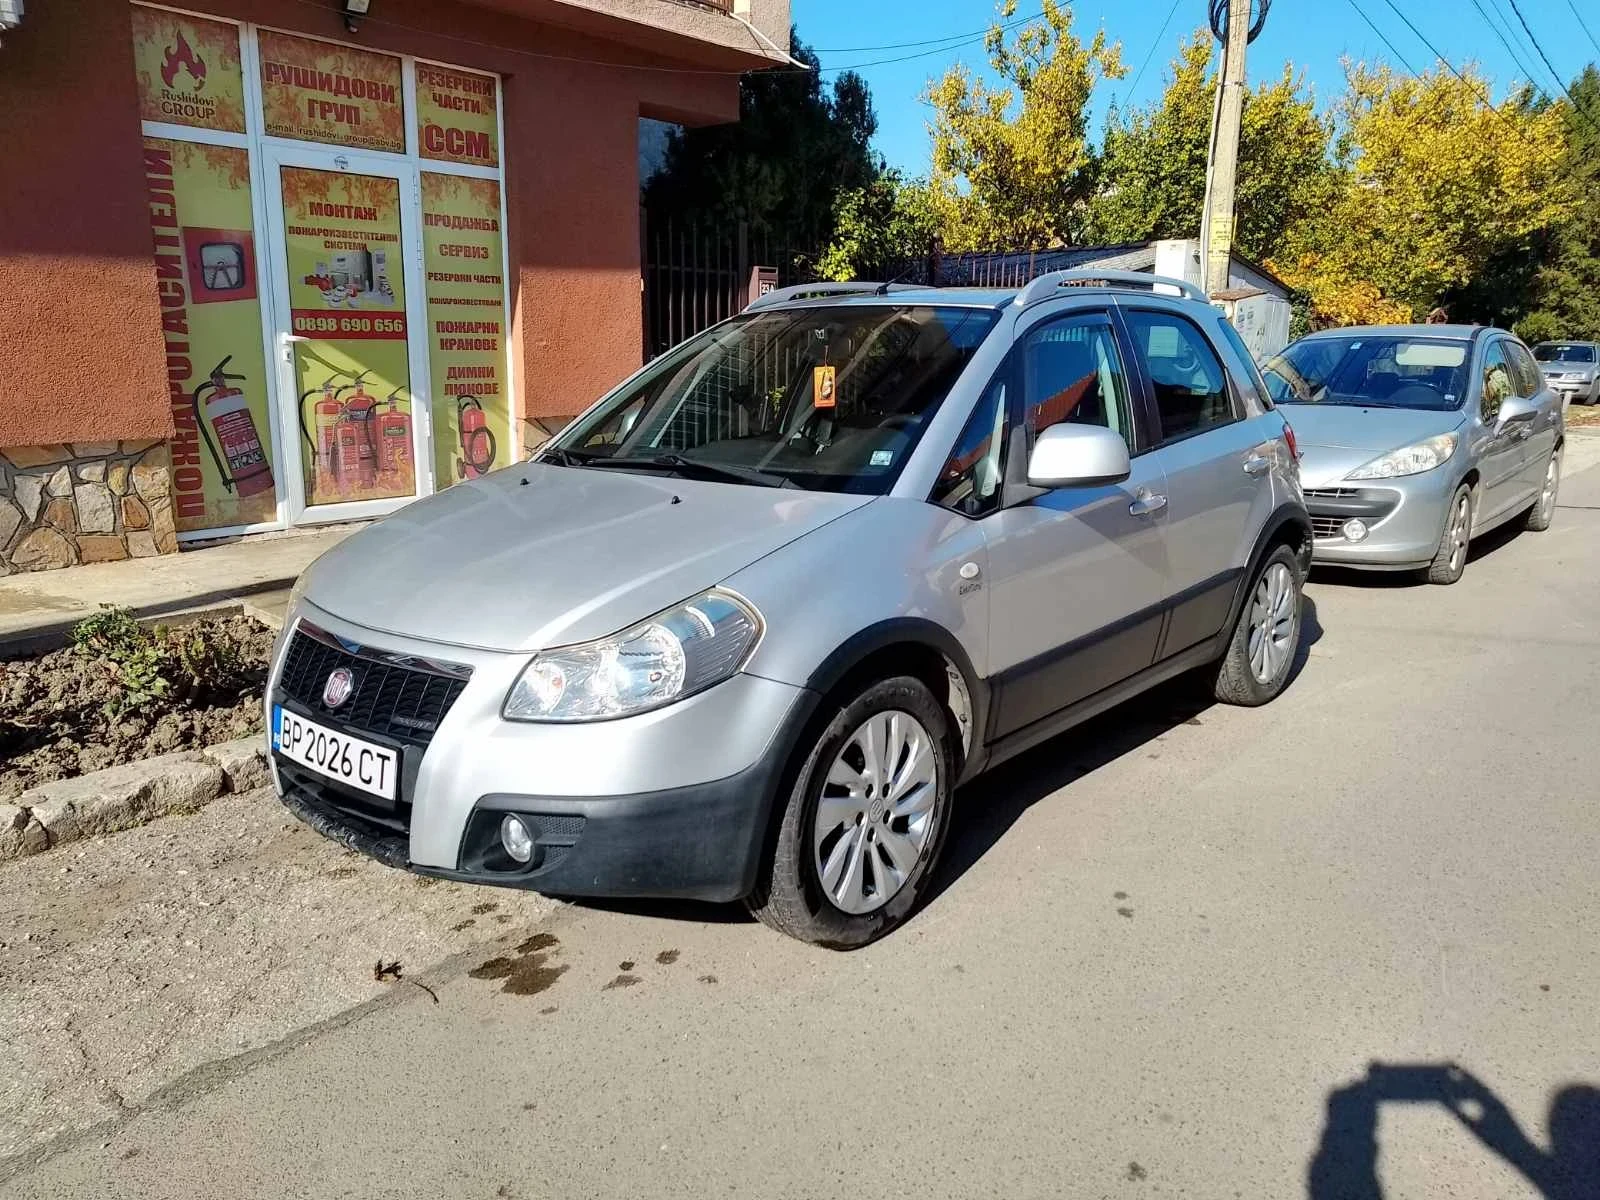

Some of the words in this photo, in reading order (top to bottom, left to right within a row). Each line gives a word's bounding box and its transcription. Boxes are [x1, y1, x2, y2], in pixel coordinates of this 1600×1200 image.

[265, 63, 395, 104] РУШИДОВИ
[418, 70, 492, 97] РЕЗЕРВНИ
[161, 89, 214, 106] Rushidovi
[432, 92, 481, 114] ЧАСТИ
[161, 101, 215, 119] GROUP
[308, 99, 361, 125] ГРУП
[309, 202, 378, 221] МОНТАЖ
[424, 213, 499, 232] ПРОДАЖБА
[324, 240, 368, 251] СИСТЕМИ
[439, 243, 489, 260] СЕРВИЗ
[428, 272, 472, 283] РЕЗЕРВНИ
[473, 273, 501, 285] ЧАСТИ
[295, 317, 337, 331] 0898
[341, 318, 371, 332] 690
[374, 319, 403, 332] 656
[436, 321, 500, 334] ПОЖАРНИ
[440, 338, 498, 351] КРАНОВЕ
[447, 366, 495, 381] ДИМНИ
[282, 716, 302, 752] BP
[304, 728, 353, 777] 2026
[358, 748, 391, 790] CT
